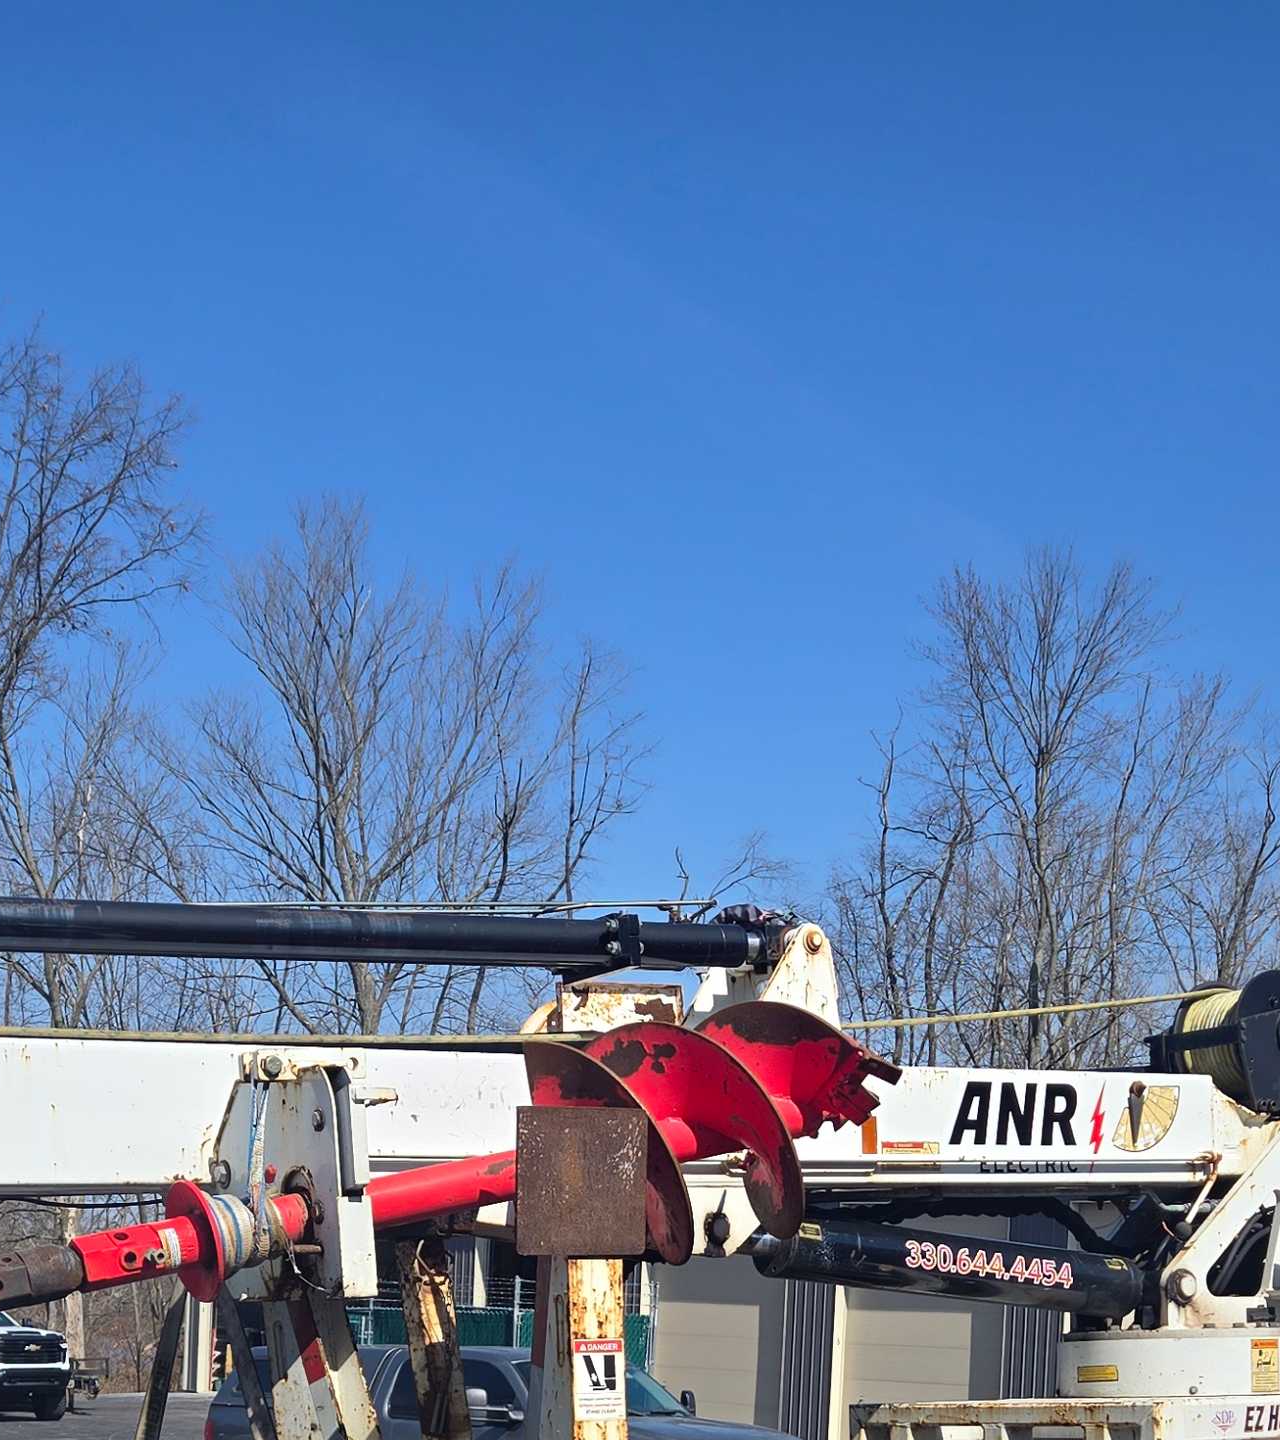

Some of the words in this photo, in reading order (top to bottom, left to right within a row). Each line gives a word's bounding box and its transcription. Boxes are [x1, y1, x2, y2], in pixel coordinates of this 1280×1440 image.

[949, 1081, 1077, 1146] ANR
[979, 1160, 1078, 1173] ELECTRIC
[904, 1239, 1074, 1290] 330.644.4454
[587, 1343, 619, 1351] DANGER
[1244, 1405, 1265, 1433] EZ
